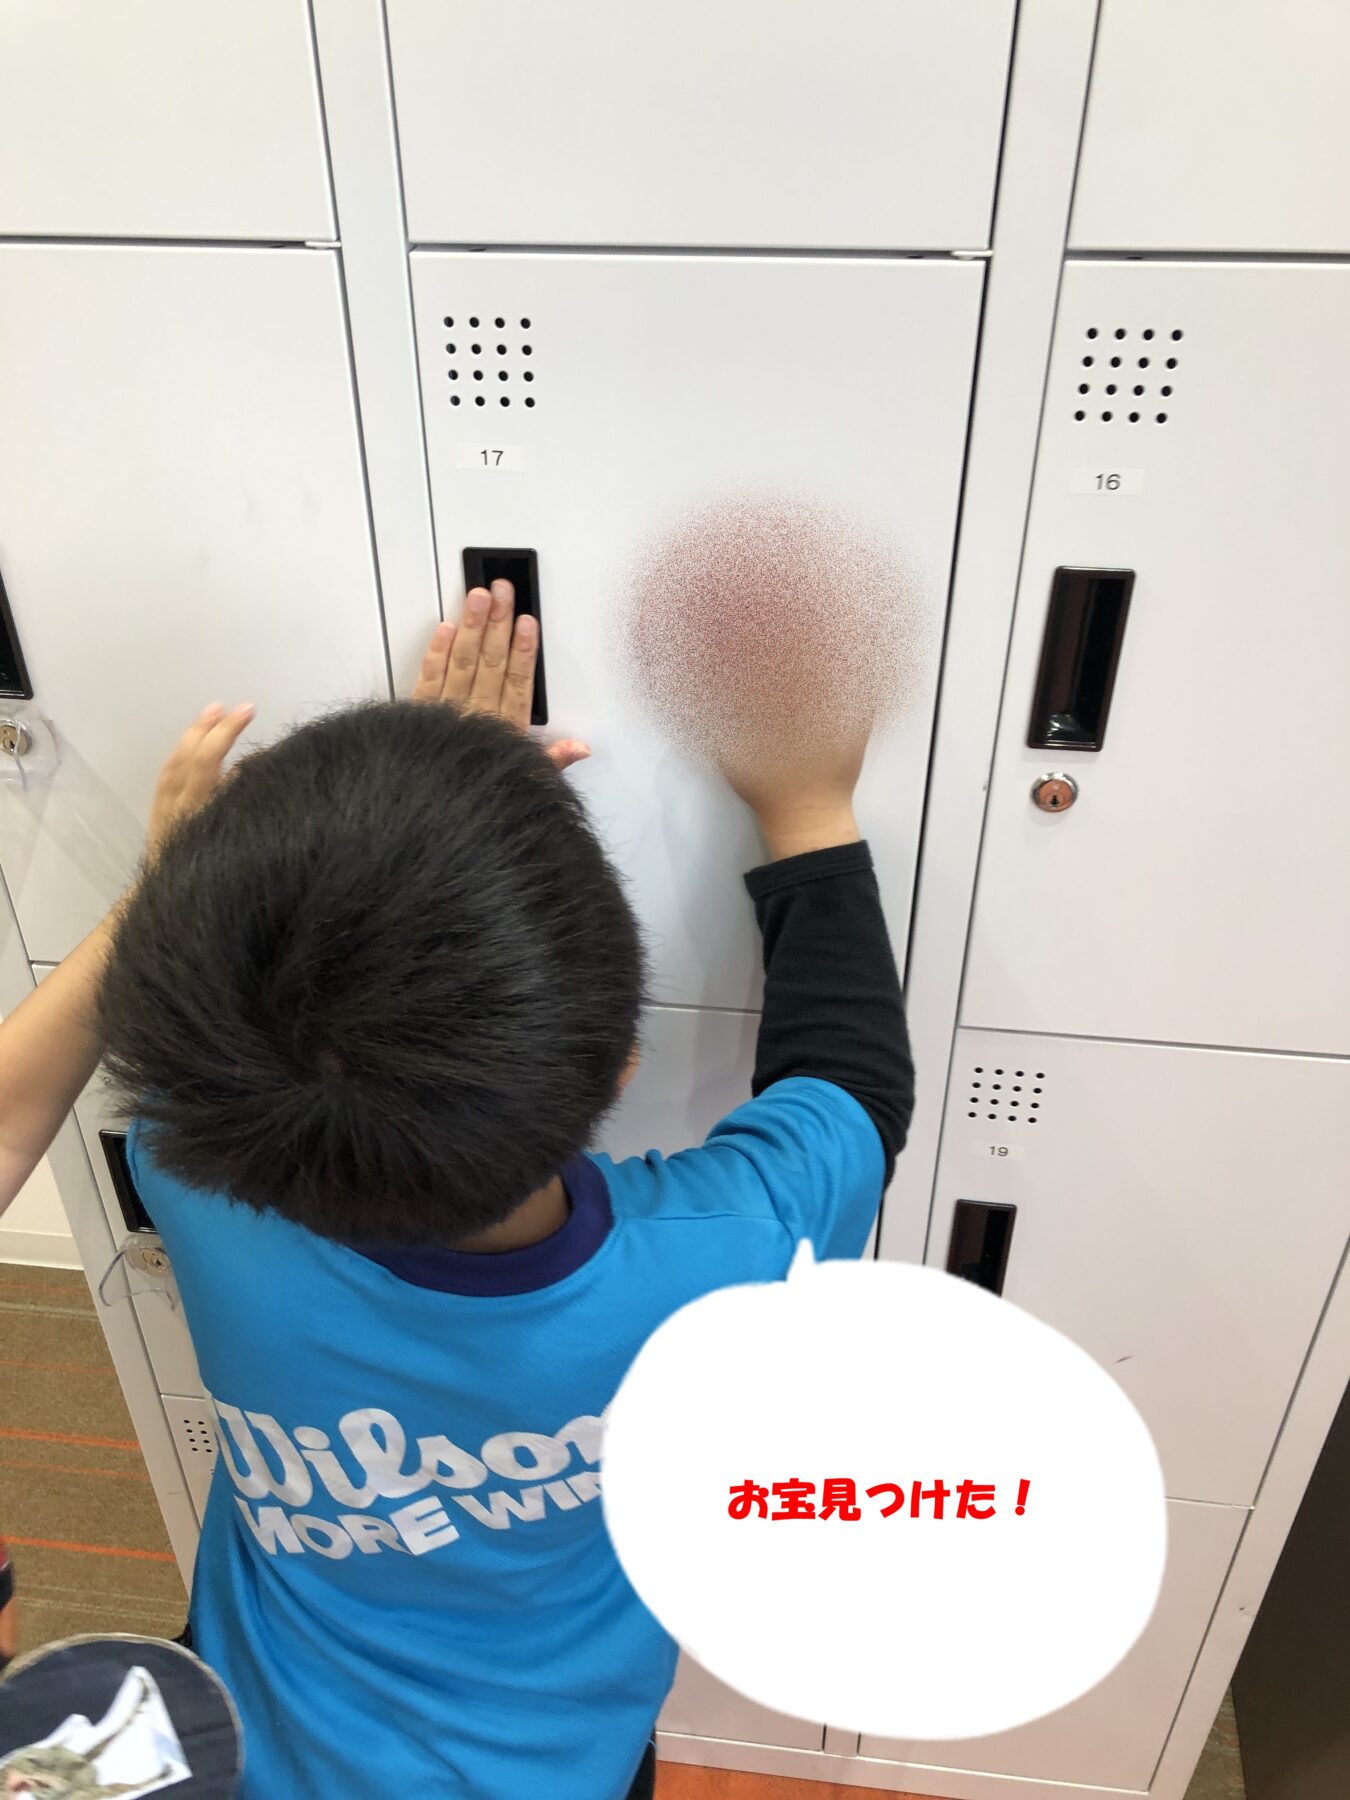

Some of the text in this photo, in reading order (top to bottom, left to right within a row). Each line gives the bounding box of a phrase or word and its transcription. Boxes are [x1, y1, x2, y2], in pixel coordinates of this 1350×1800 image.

[480, 449, 504, 466] 17
[1095, 473, 1122, 491] 16
[989, 1146, 1009, 1157] 19
[233, 1494, 460, 1560] MORE
